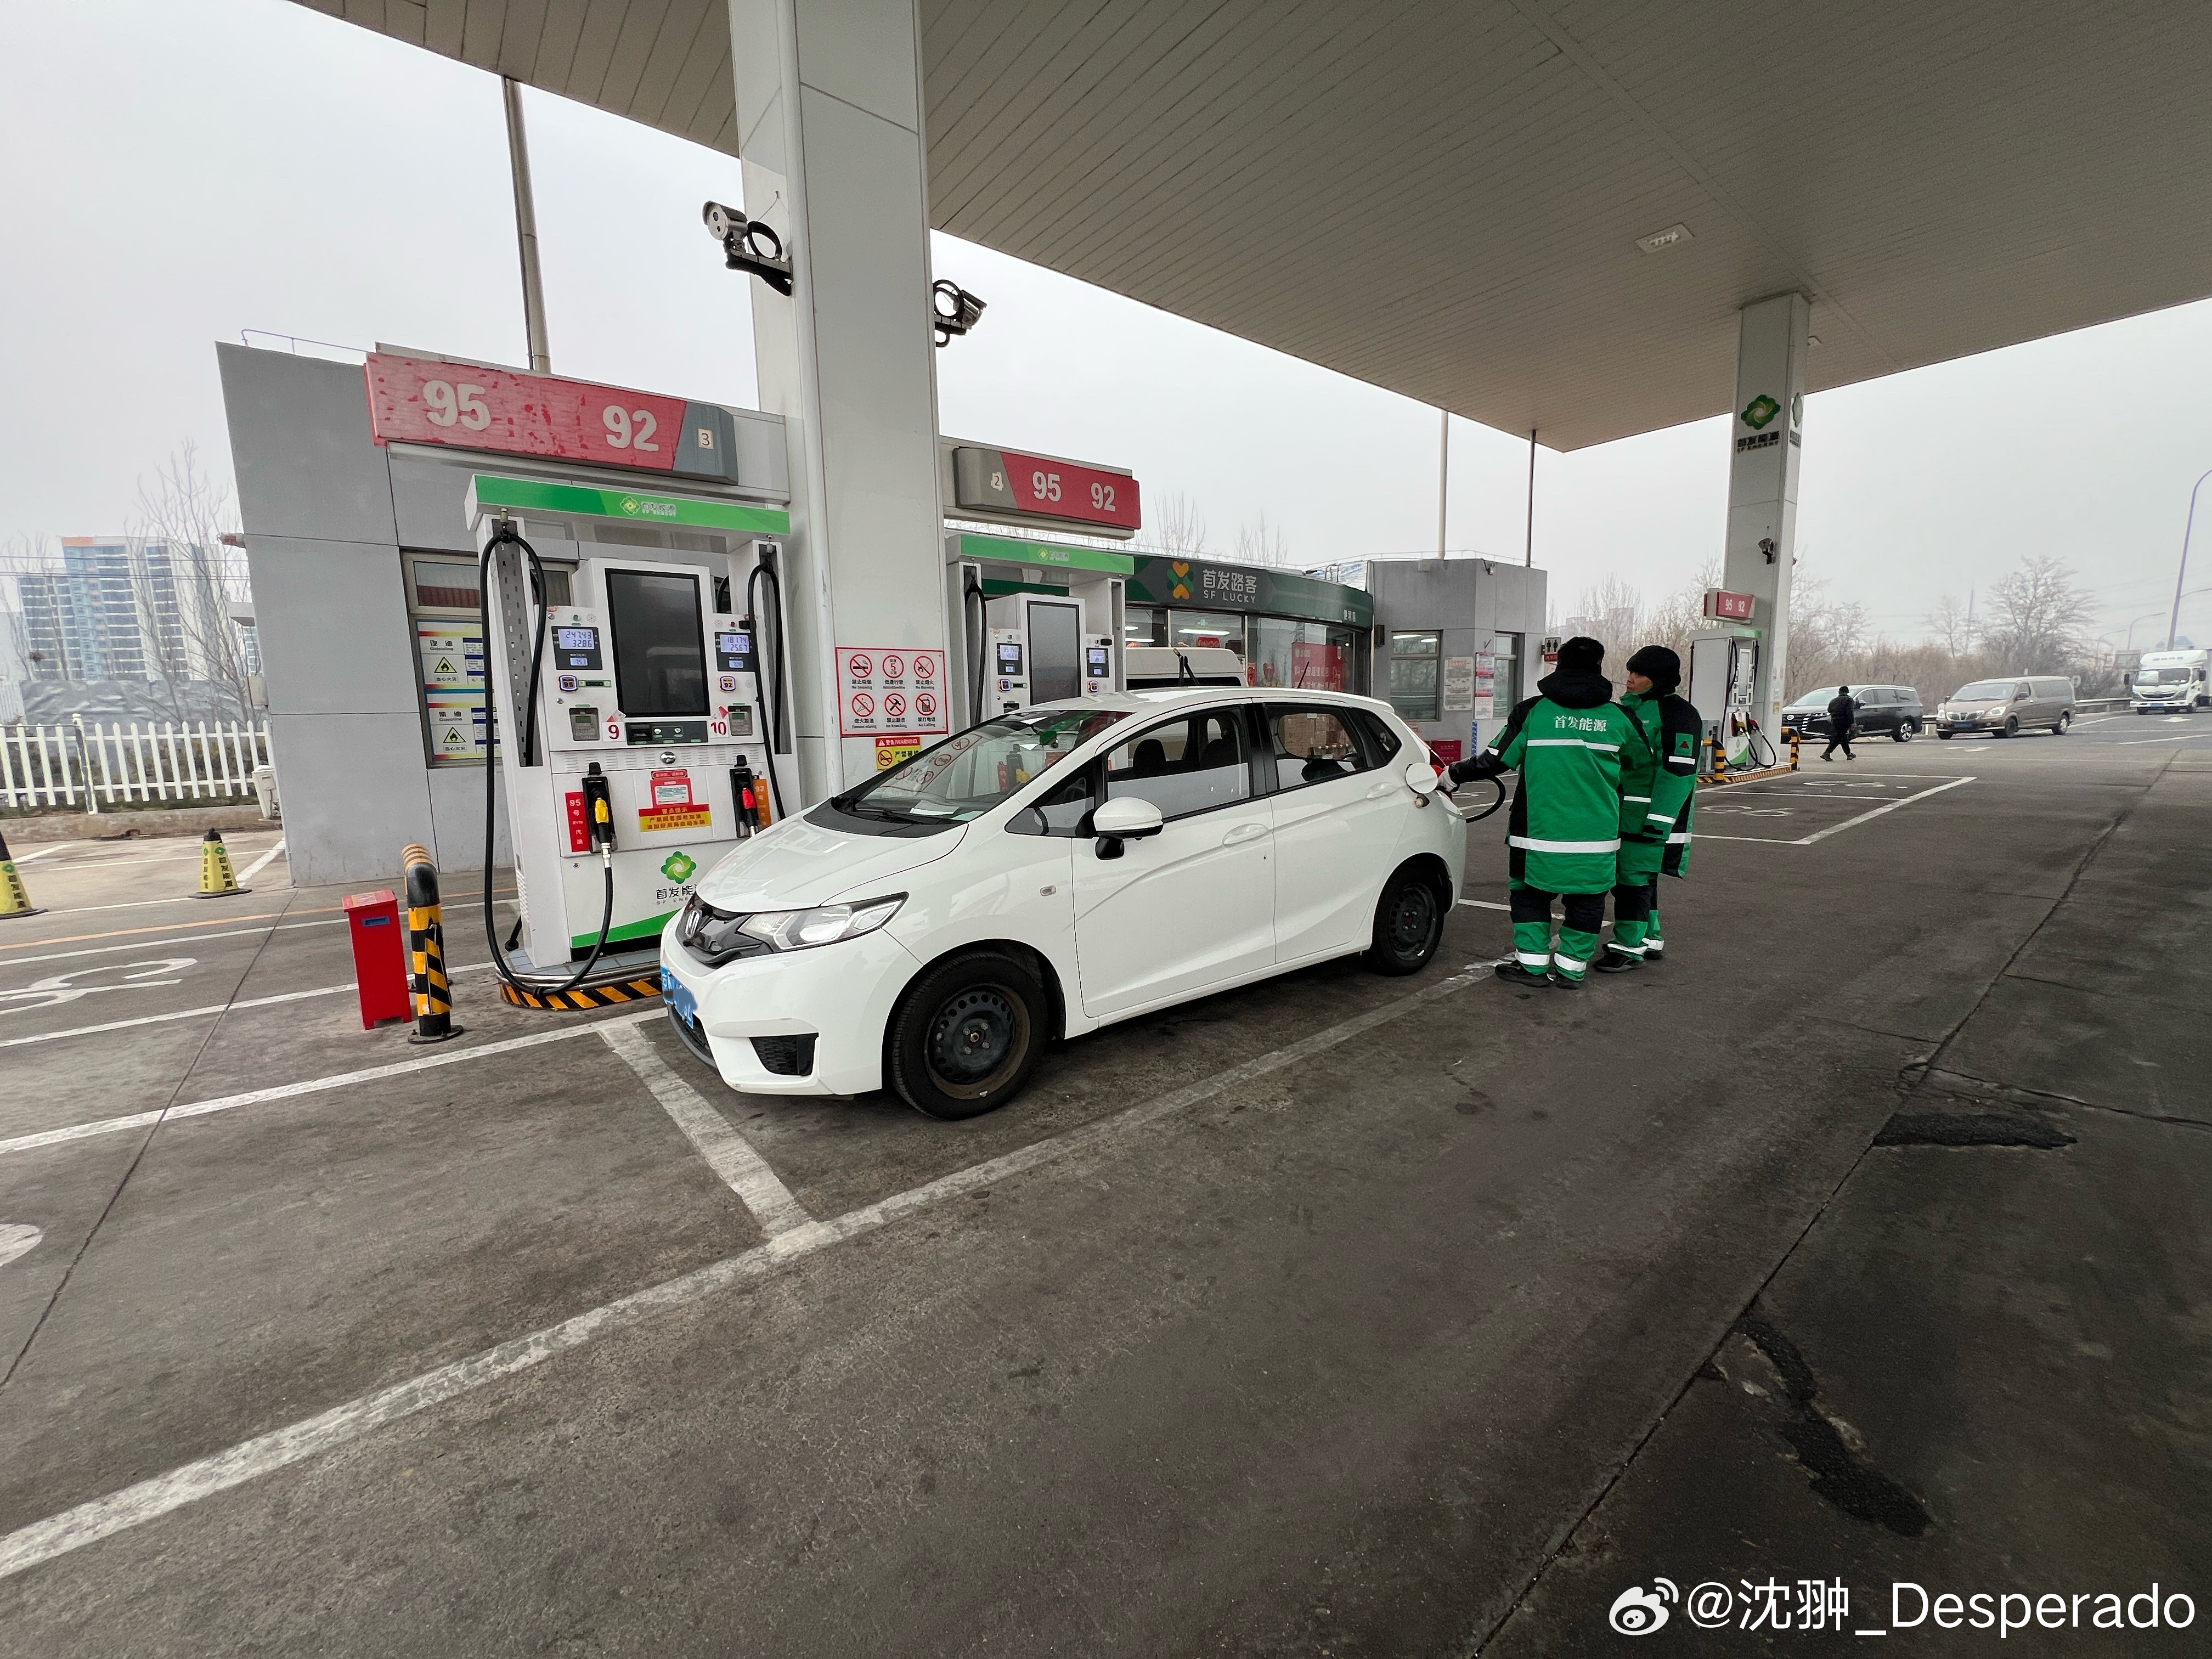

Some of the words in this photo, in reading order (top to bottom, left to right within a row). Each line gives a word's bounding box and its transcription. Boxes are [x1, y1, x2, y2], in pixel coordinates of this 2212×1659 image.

[423, 380, 490, 431] 95
[602, 405, 659, 452] 92
[701, 432, 710, 447] 3
[994, 475, 1001, 487] 2
[1032, 471, 1062, 502] 95
[1091, 482, 1115, 512] 92
[1203, 569, 1257, 594] 首发路客
[1204, 590, 1216, 599] SF
[1222, 591, 1256, 603] LUCKY
[710, 721, 727, 735] 10
[1554, 715, 1607, 732] 首发能源
[608, 724, 620, 740] 9
[656, 884, 697, 899] 首发能
